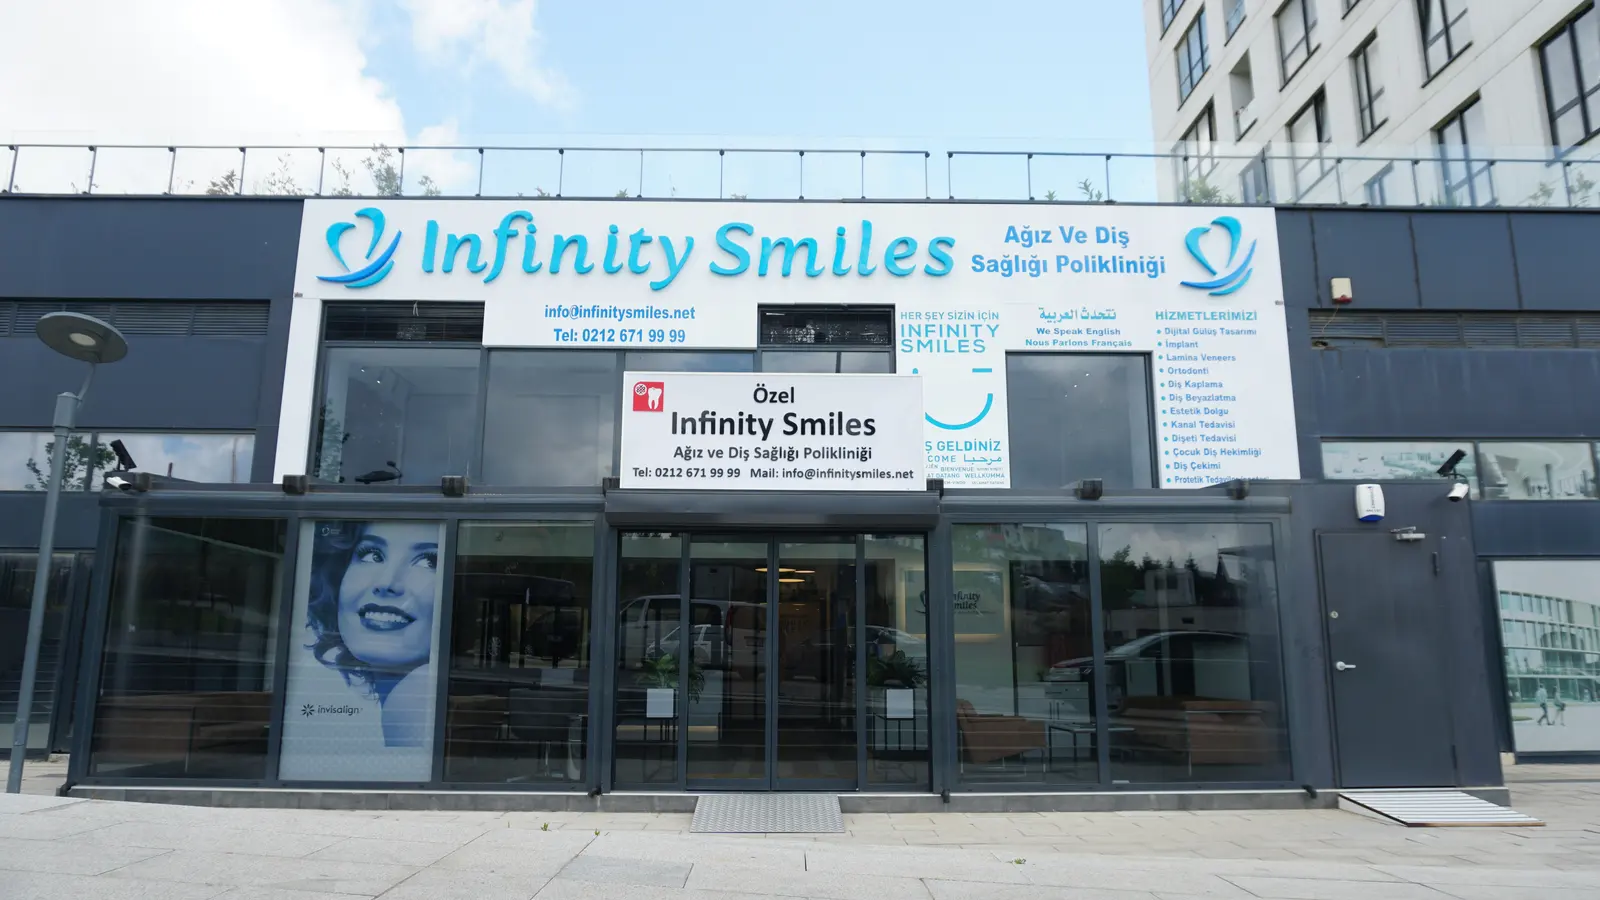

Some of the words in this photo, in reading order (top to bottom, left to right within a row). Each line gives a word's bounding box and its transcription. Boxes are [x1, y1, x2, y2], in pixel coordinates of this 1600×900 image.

[1004, 225, 1052, 248] Ağız
[1059, 226, 1088, 244] Ve
[1095, 226, 1130, 249] Diş
[421, 210, 694, 291] Infinity
[709, 219, 956, 278] Smiles
[971, 254, 1048, 278] Sağlığı
[1056, 255, 1166, 279] Polikliniği
[544, 304, 696, 322] info@infinitysmiles.net
[900, 311, 922, 320] HER
[925, 311, 945, 323] ŞEY
[947, 310, 975, 320] SİZİN
[978, 310, 999, 322] İÇİN
[1038, 307, 1078, 323] العربية
[1080, 307, 1117, 320] نتحدث
[1155, 309, 1257, 321] HİZMETLERİMİZİ
[553, 328, 578, 342] Tel:
[582, 328, 615, 342] 0212
[619, 329, 643, 342] 671
[649, 329, 665, 342] 99
[669, 329, 686, 342] 99
[901, 324, 1000, 338] INFINITY
[1036, 327, 1051, 335] We
[1053, 327, 1083, 336] Speak
[1086, 327, 1121, 337] English
[1164, 327, 1190, 336] Dijital
[1192, 327, 1217, 336] Gülüş
[1219, 327, 1257, 335] Tasarımı
[901, 339, 986, 353] SMILES
[1091, 339, 1133, 348] Français
[1165, 340, 1199, 350] İmplant
[1166, 353, 1198, 361] Lamina
[1200, 353, 1236, 361] Veneers
[1167, 366, 1209, 375] Ortodonti
[1168, 380, 1182, 389] Diş
[1184, 380, 1223, 389] Kaplama
[753, 383, 795, 404] Özel
[1169, 393, 1183, 403] Diş
[1185, 393, 1236, 403] Beyazlatma
[1170, 407, 1201, 415] Estetik
[1204, 407, 1229, 417] Dolgu
[671, 410, 774, 441] Infinity
[782, 410, 876, 436] Smiles
[1171, 420, 1197, 428] Kanal
[1199, 420, 1236, 429] Tedavisi
[936, 438, 1002, 451] GELDİNİZ
[1171, 434, 1197, 444] Dişeti
[1200, 434, 1237, 442] Tedavisi
[673, 446, 704, 461] Ağız
[707, 449, 724, 458] ve
[728, 446, 750, 461] Diş
[753, 446, 799, 461] Sağlığı
[803, 446, 872, 462] Polikliniği
[927, 454, 957, 463] COME
[1172, 448, 1200, 457] Çocuk
[1203, 448, 1217, 457] Diş
[1220, 448, 1262, 457] Hekimliği
[963, 453, 1003, 466] مرحبا
[1173, 461, 1188, 471] Diş
[1190, 461, 1221, 471] Çekimi
[633, 467, 652, 477] Tel:
[655, 467, 683, 478] 0212
[686, 468, 707, 478] 671
[710, 468, 724, 478] 99
[727, 468, 741, 478] 99
[750, 468, 779, 478] Mail:
[782, 468, 914, 481] info@infinitysmiles.net
[1174, 475, 1204, 483] Protetik
[317, 705, 360, 716] invisalign
